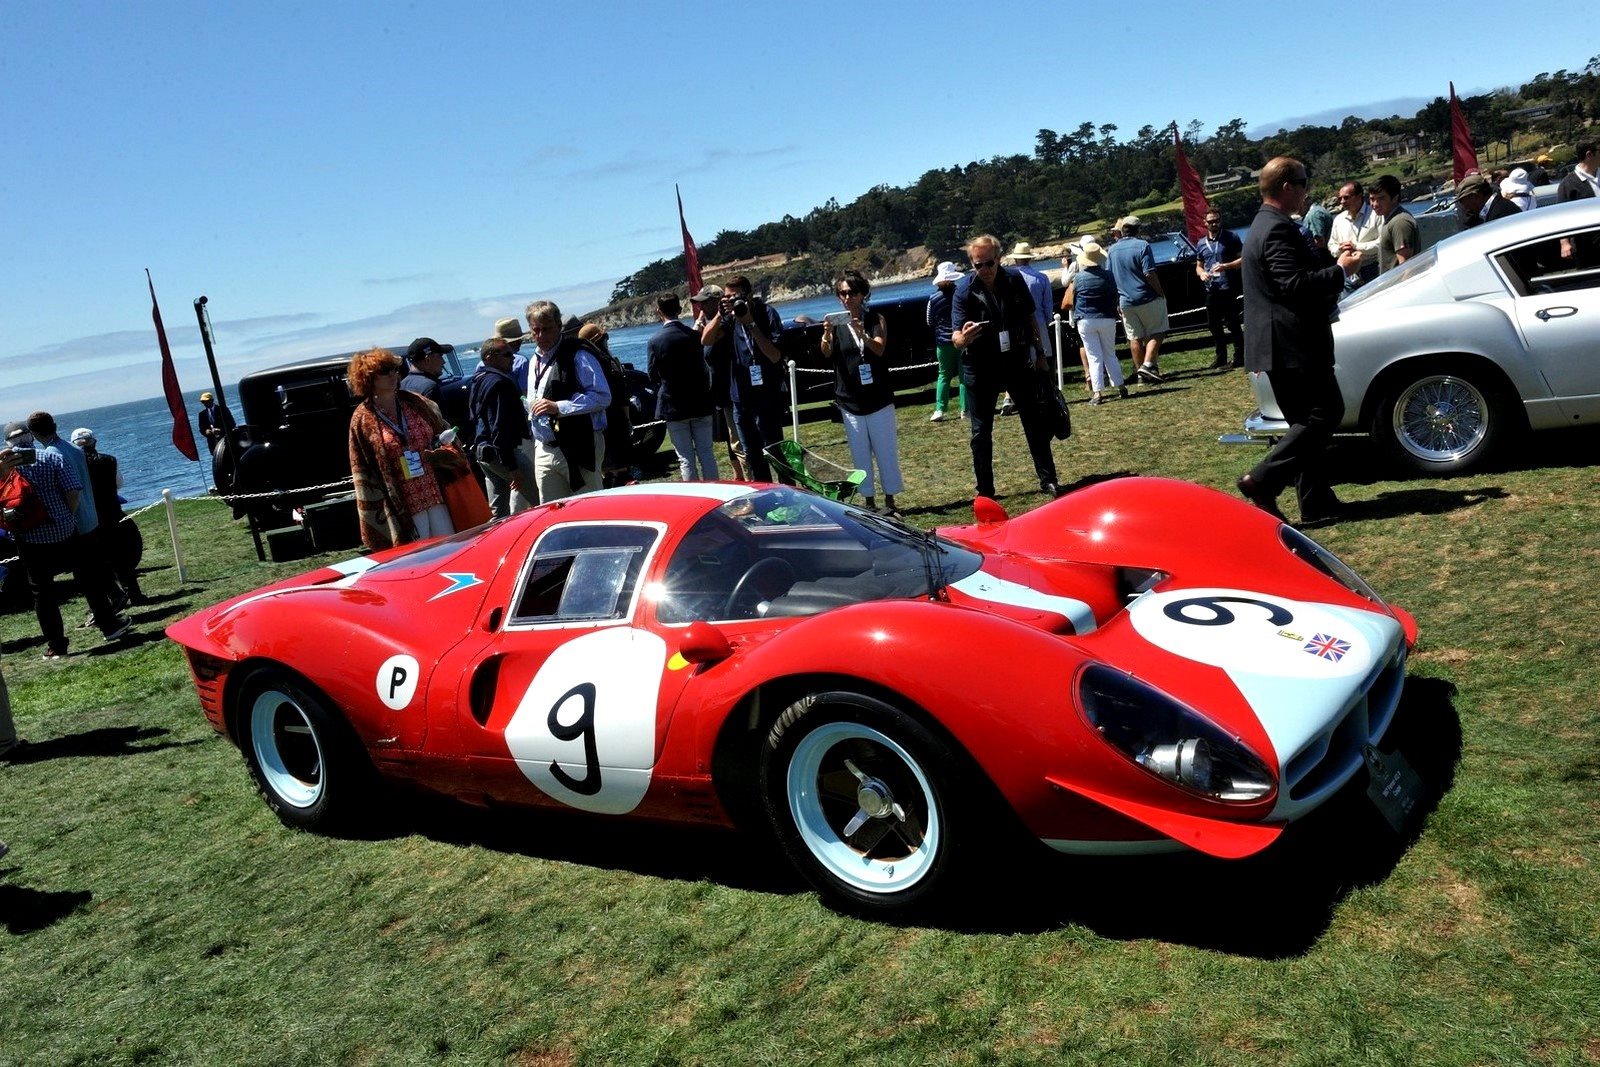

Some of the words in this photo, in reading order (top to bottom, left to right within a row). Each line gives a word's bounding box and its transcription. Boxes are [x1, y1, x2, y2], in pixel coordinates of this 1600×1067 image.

[1163, 597, 1294, 626] 9
[390, 666, 407, 698] P
[548, 682, 602, 795] 9
